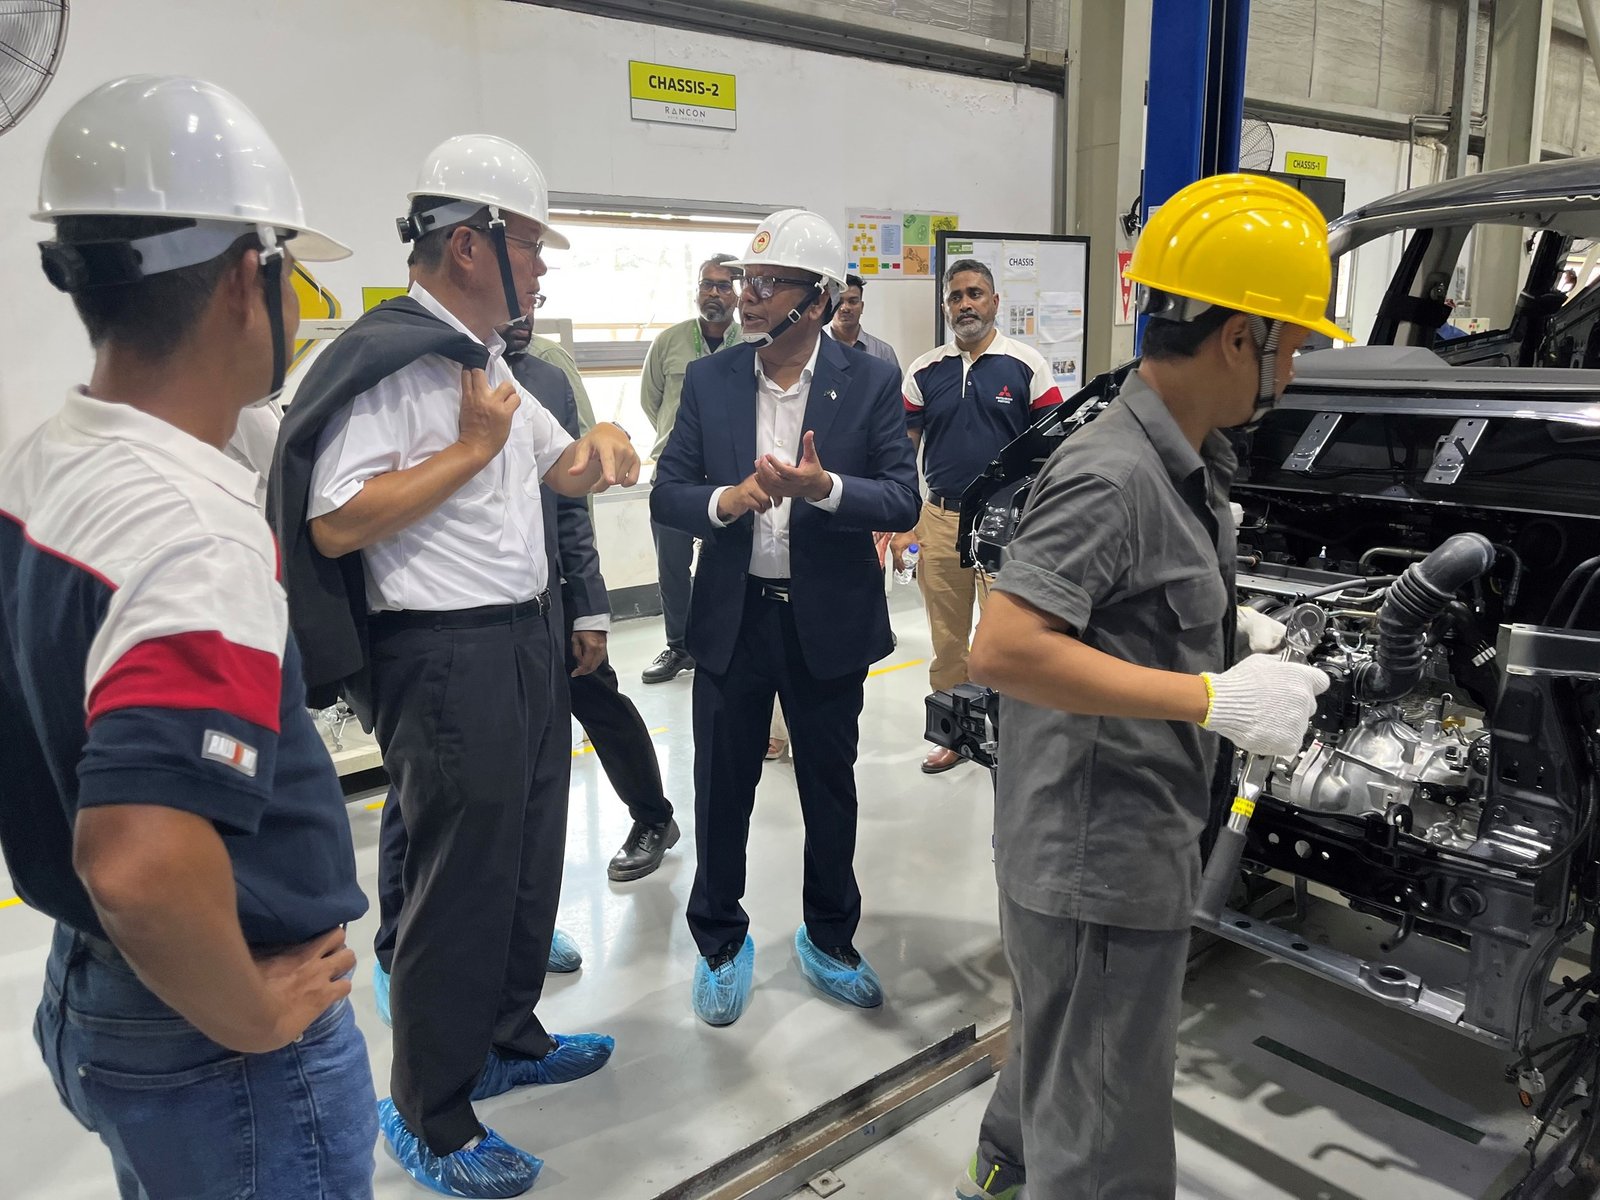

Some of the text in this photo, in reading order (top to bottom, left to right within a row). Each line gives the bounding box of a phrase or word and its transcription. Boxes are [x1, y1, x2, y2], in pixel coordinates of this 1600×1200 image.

[648, 75, 719, 96] CHASSIS-2
[664, 106, 706, 118] RANCON
[1293, 160, 1320, 170] CHASSIS-1
[1008, 257, 1034, 267] CHASSIS
